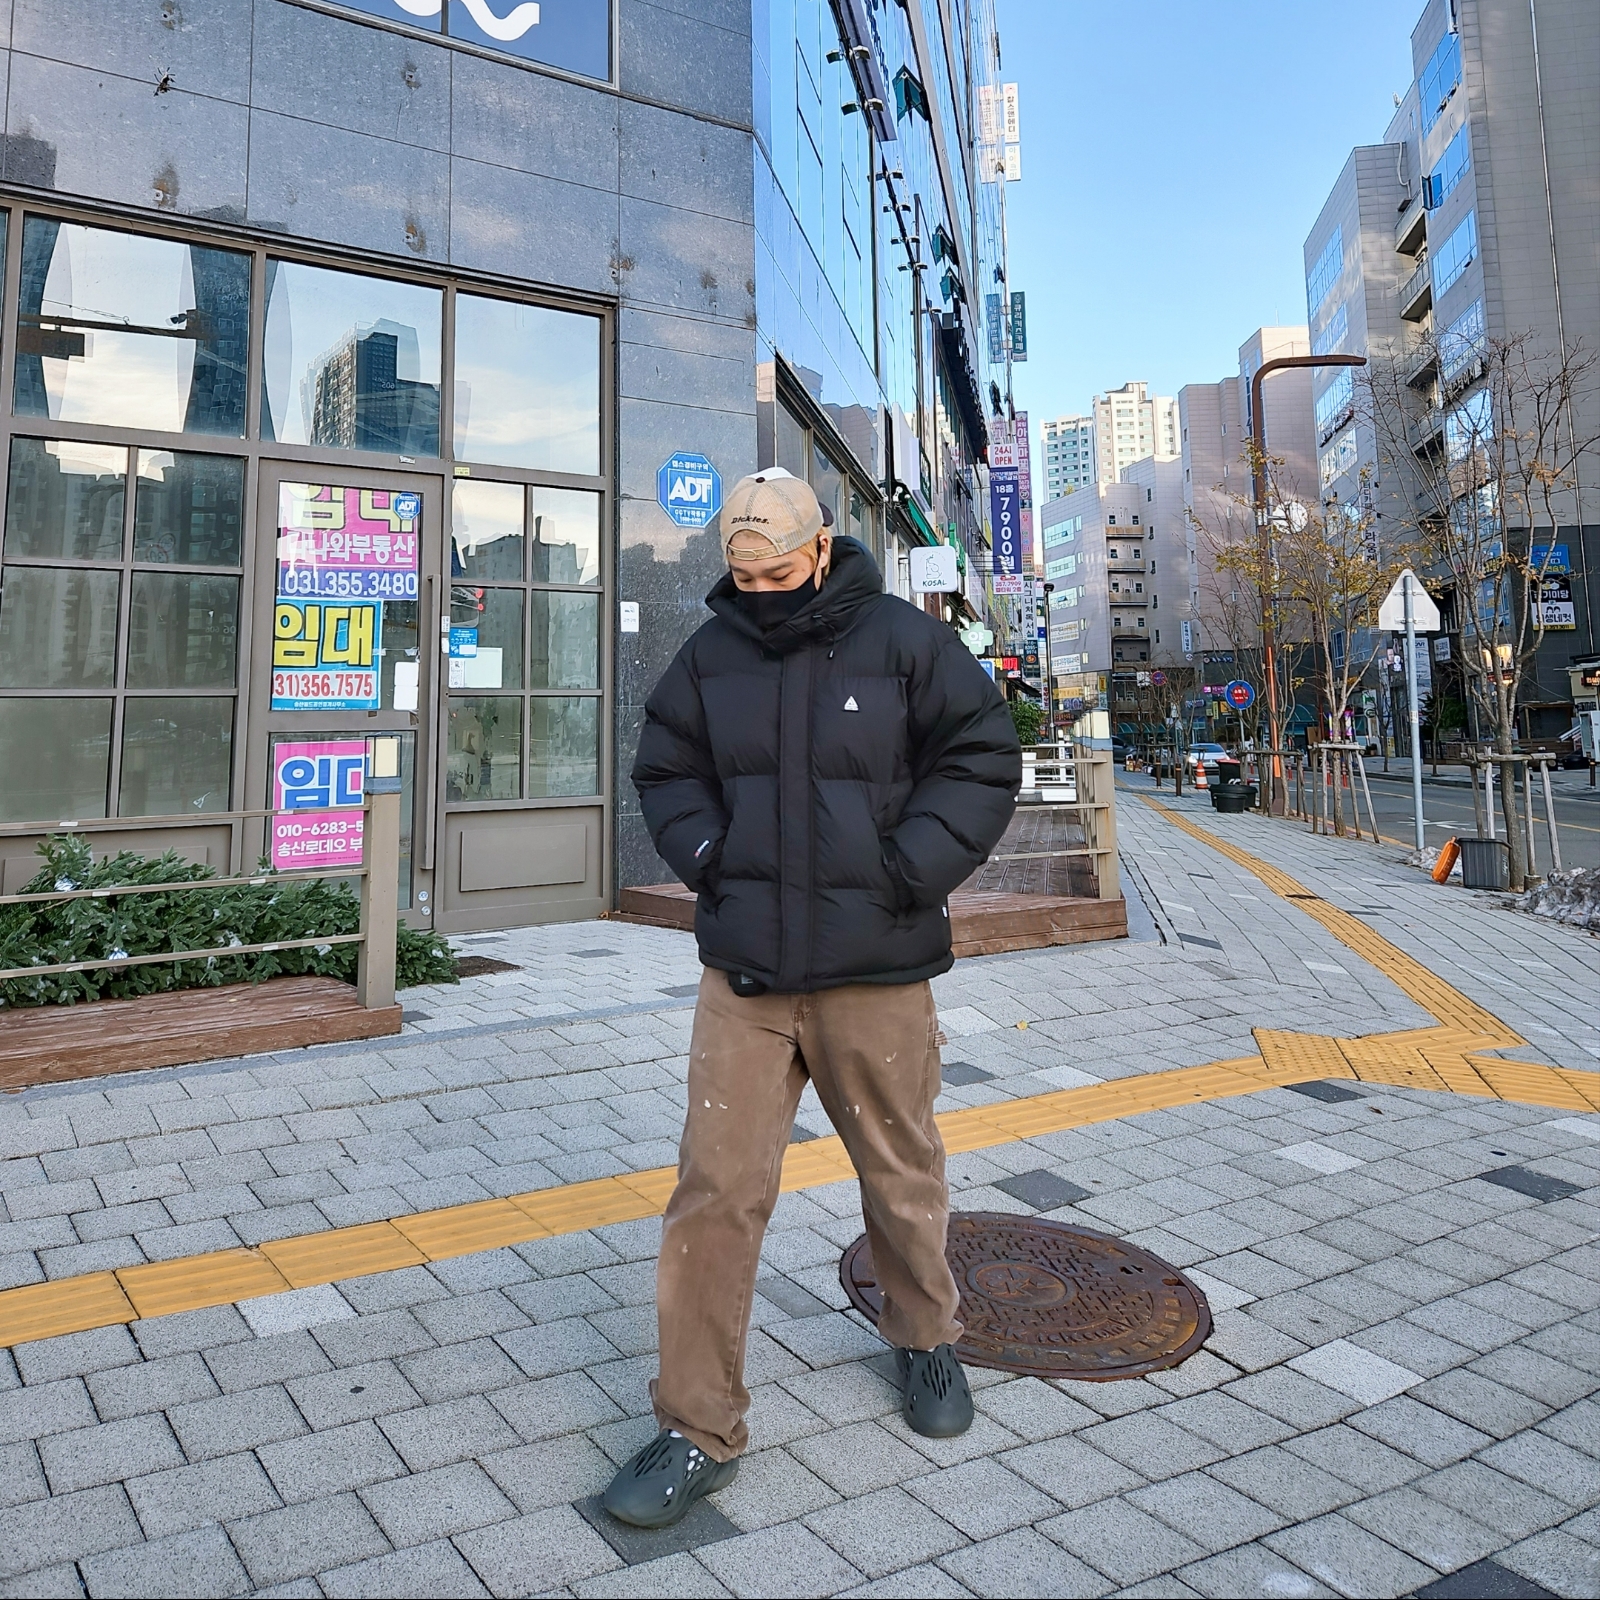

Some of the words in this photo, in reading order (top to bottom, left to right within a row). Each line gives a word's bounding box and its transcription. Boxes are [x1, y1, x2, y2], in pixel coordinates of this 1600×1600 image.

[994, 445, 1012, 455] 24시
[1017, 428, 1028, 458] 아로마
[671, 460, 709, 472] 캡스경비구역
[994, 456, 1013, 466] OPEN
[668, 476, 711, 503] ADT
[398, 501, 416, 512] ADT
[285, 571, 418, 596] 031.355.3480
[922, 579, 948, 588] KOSAL
[272, 603, 374, 668] 임대
[968, 631, 984, 648] 약
[272, 674, 373, 697] 31)356.7575
[277, 820, 363, 838] 010-6283-5
[277, 839, 347, 857] 송산로데오
[349, 837, 363, 852] 부
